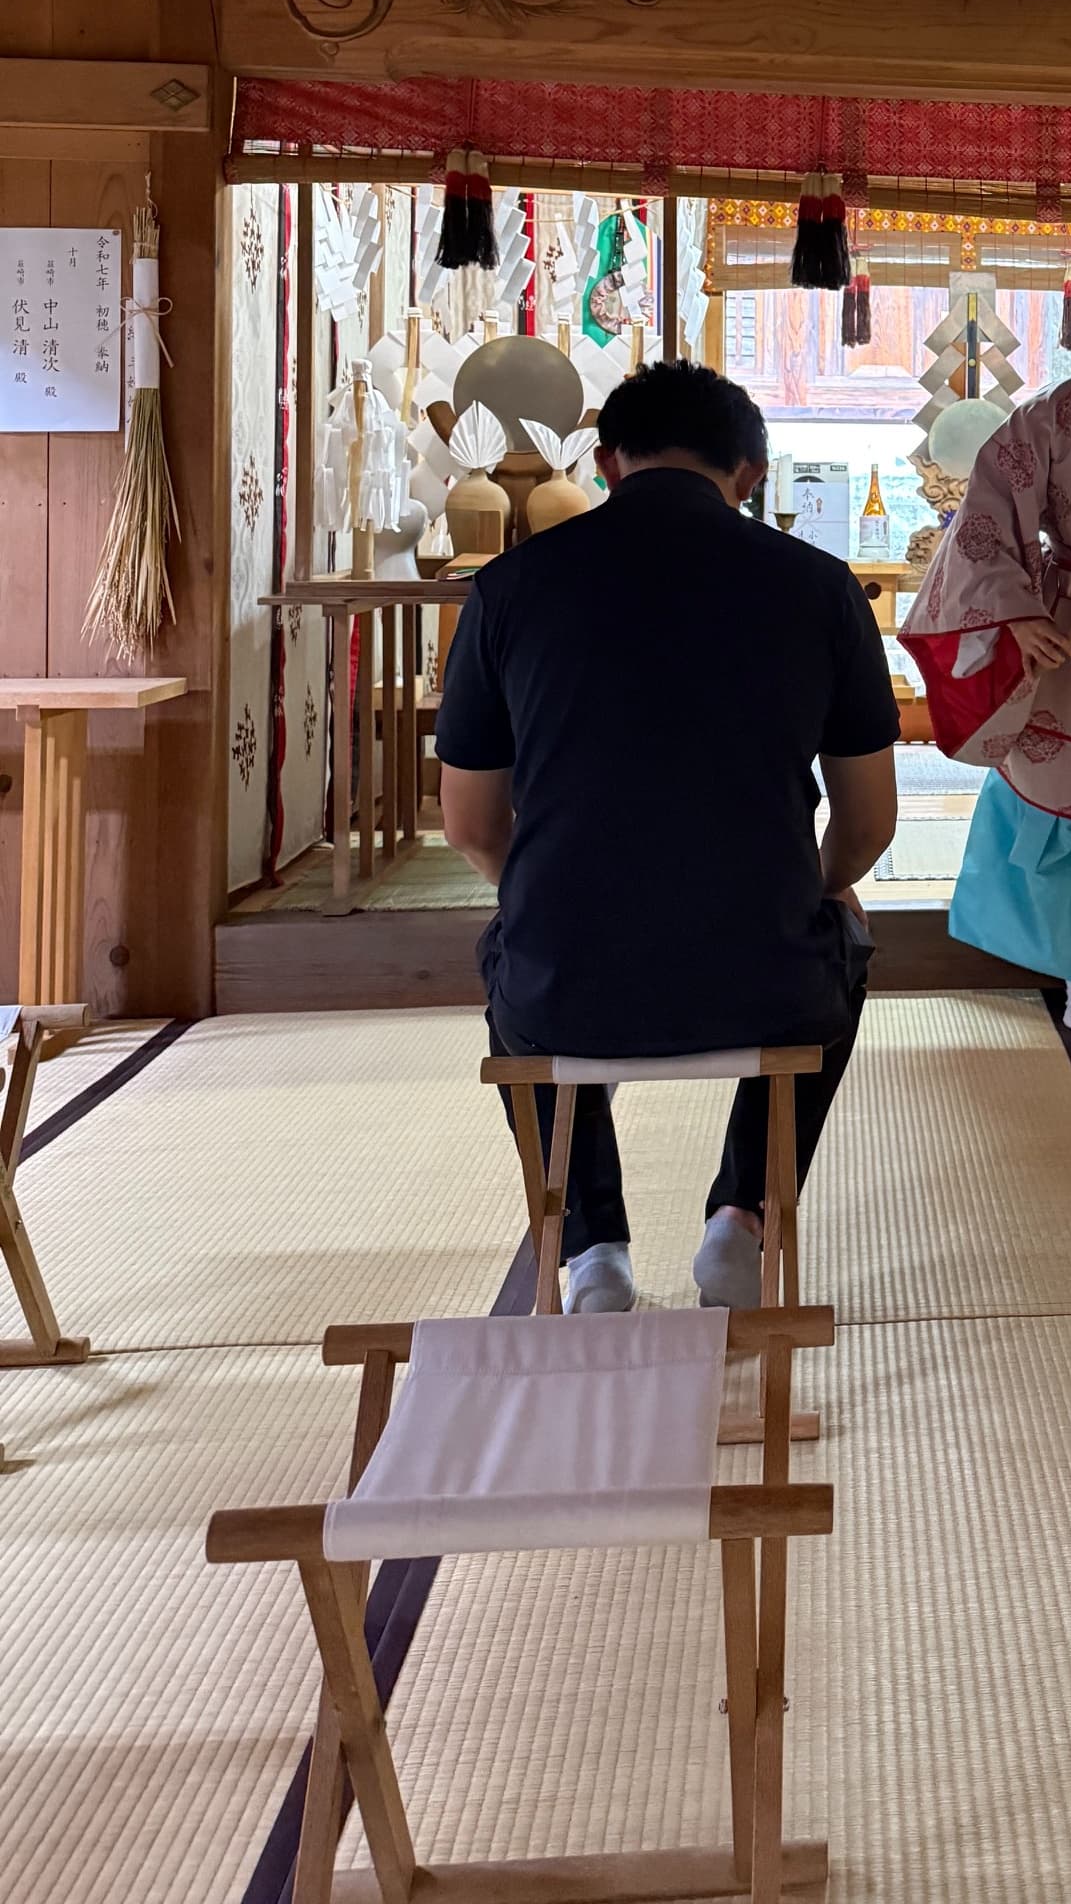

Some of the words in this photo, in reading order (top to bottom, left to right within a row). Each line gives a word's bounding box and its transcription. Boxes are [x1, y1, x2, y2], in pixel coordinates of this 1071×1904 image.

[68, 247, 78, 268] 十月
[96, 235, 110, 291] 令和七年
